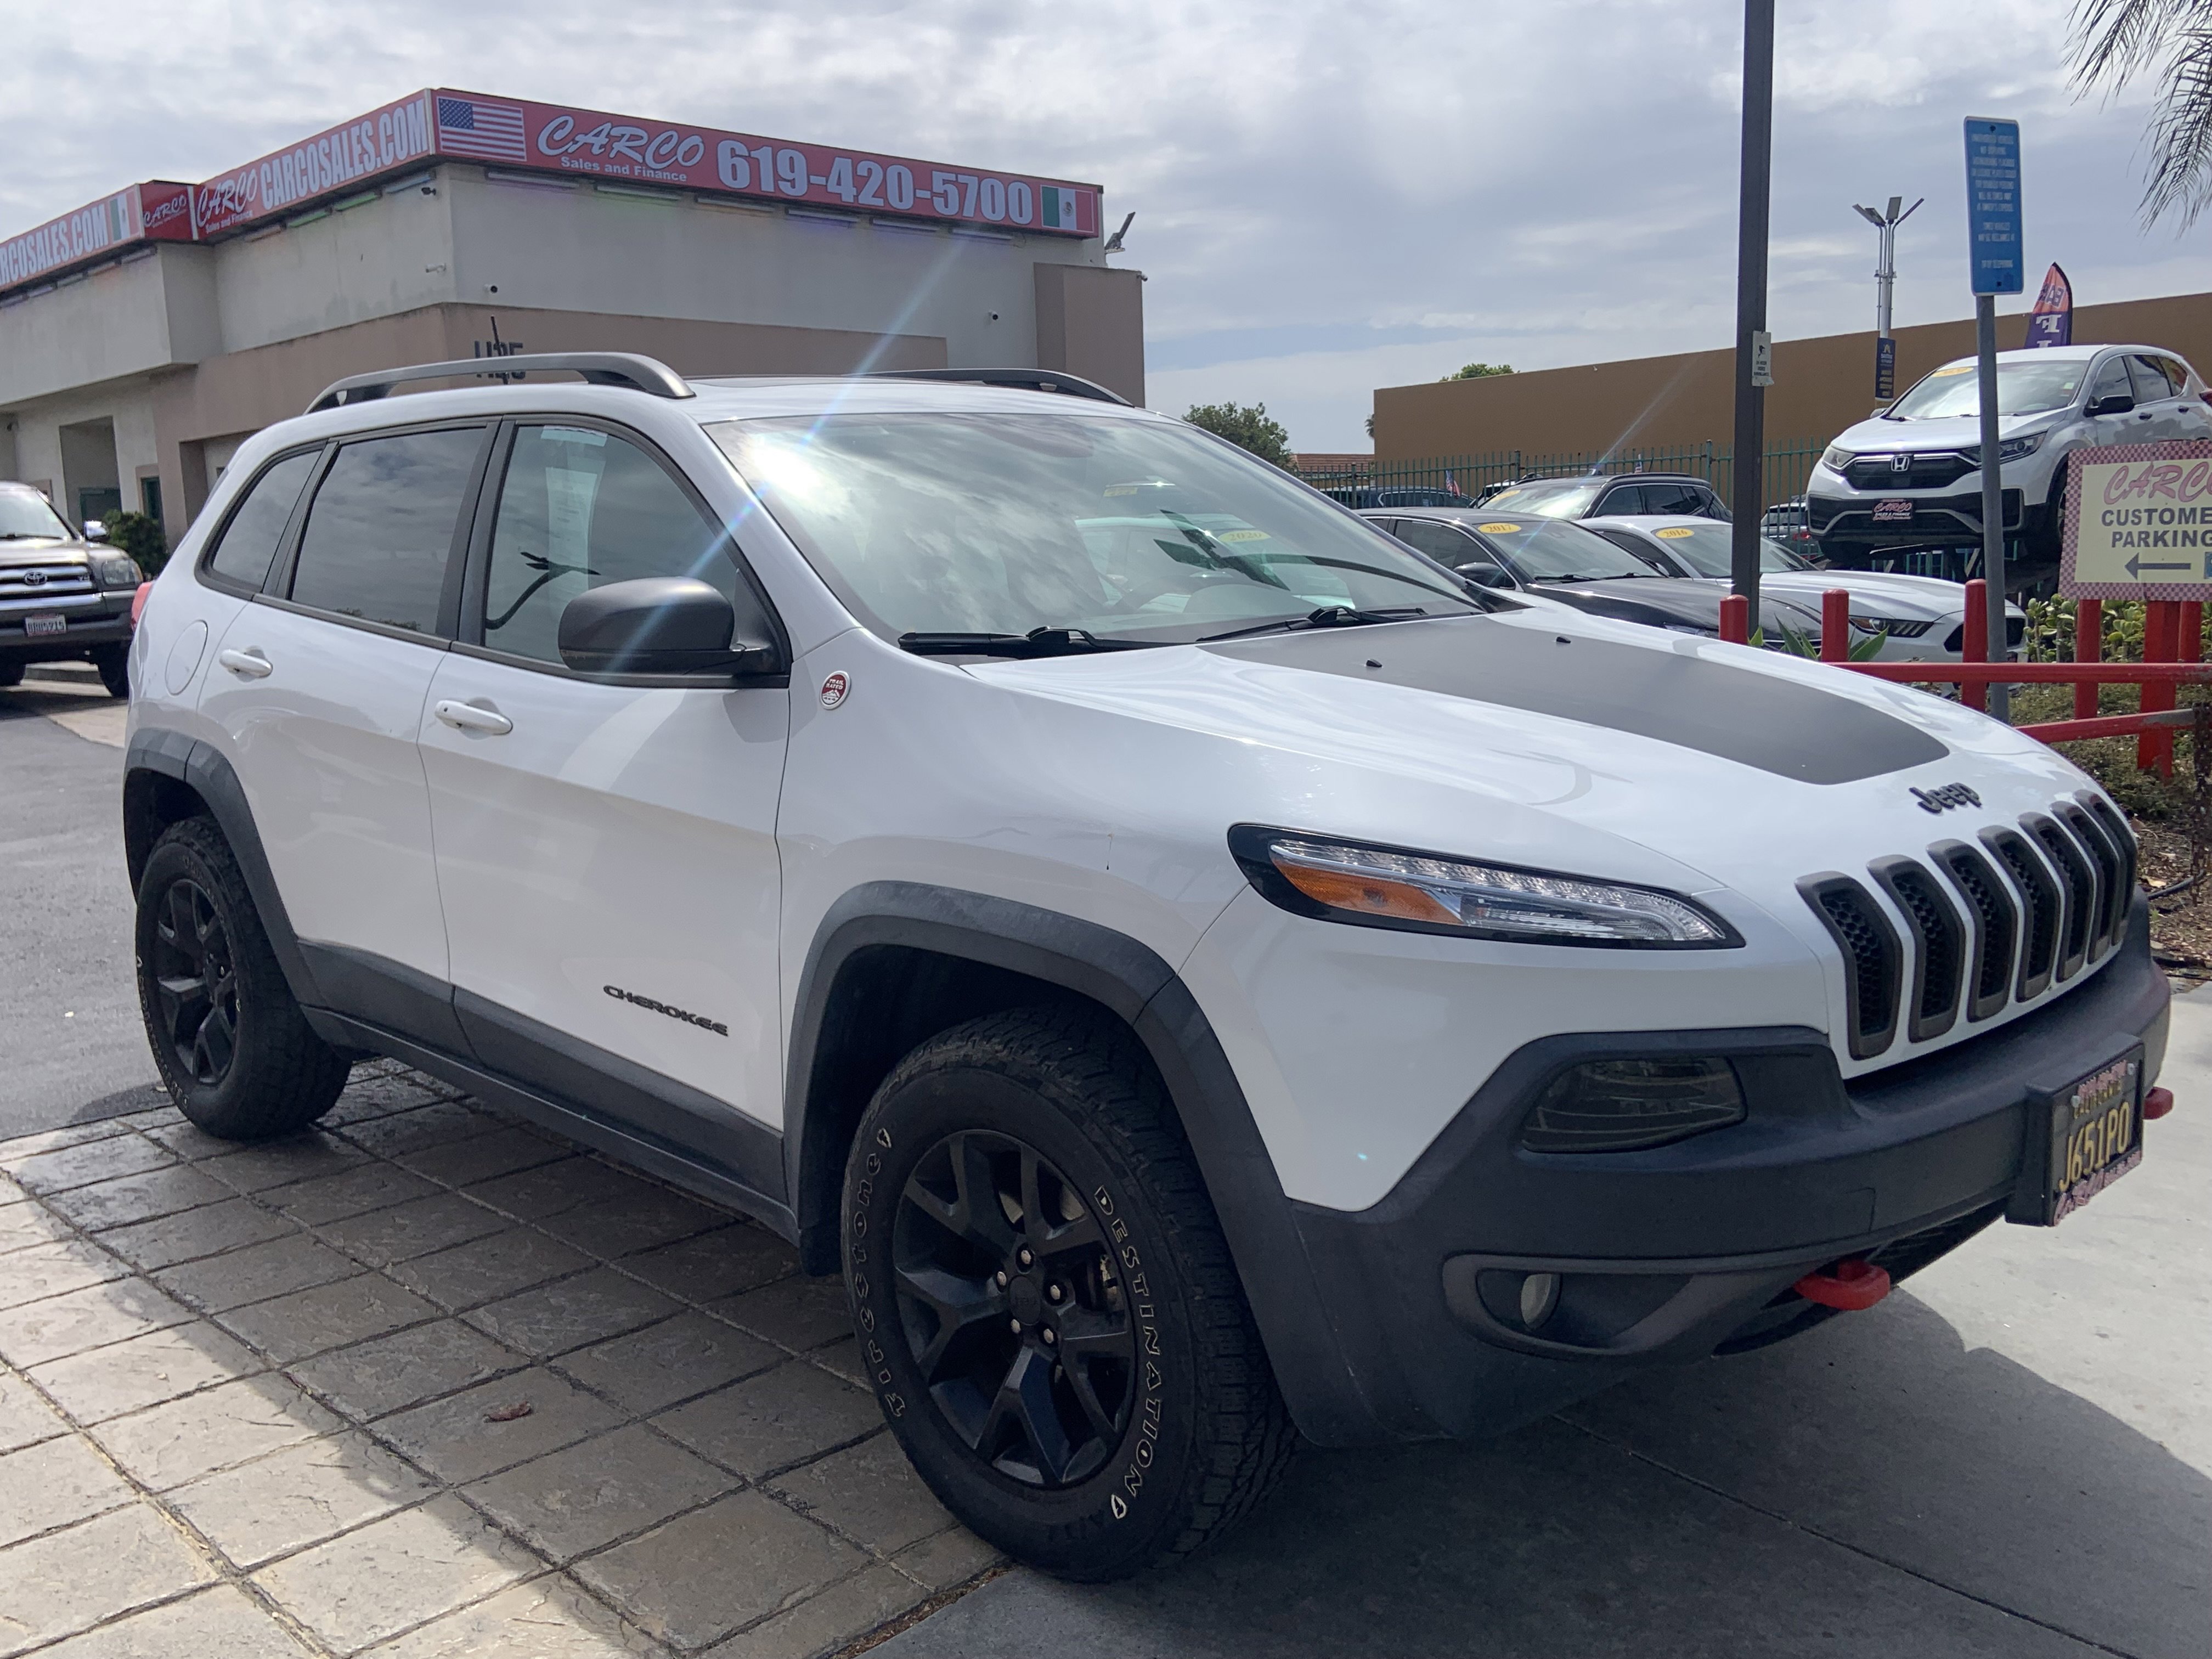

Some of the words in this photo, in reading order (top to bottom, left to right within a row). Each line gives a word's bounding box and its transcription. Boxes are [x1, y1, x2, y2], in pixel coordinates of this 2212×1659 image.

[261, 99, 428, 210] CARCOSALES.COM
[537, 115, 705, 170] CARCO
[561, 156, 600, 172] Sales
[605, 163, 630, 176] and
[634, 165, 687, 183] Finance
[717, 139, 1034, 225] 619-420-5700
[144, 195, 187, 228] CARCO
[196, 168, 257, 228] CARCO
[1486, 524, 1511, 532] 2017
[2112, 530, 2212, 548] PARKING
[1909, 782, 1982, 814] Jeep
[603, 985, 729, 1037] CHEROKEE
[1094, 1185, 1163, 1498] DESTINATION
